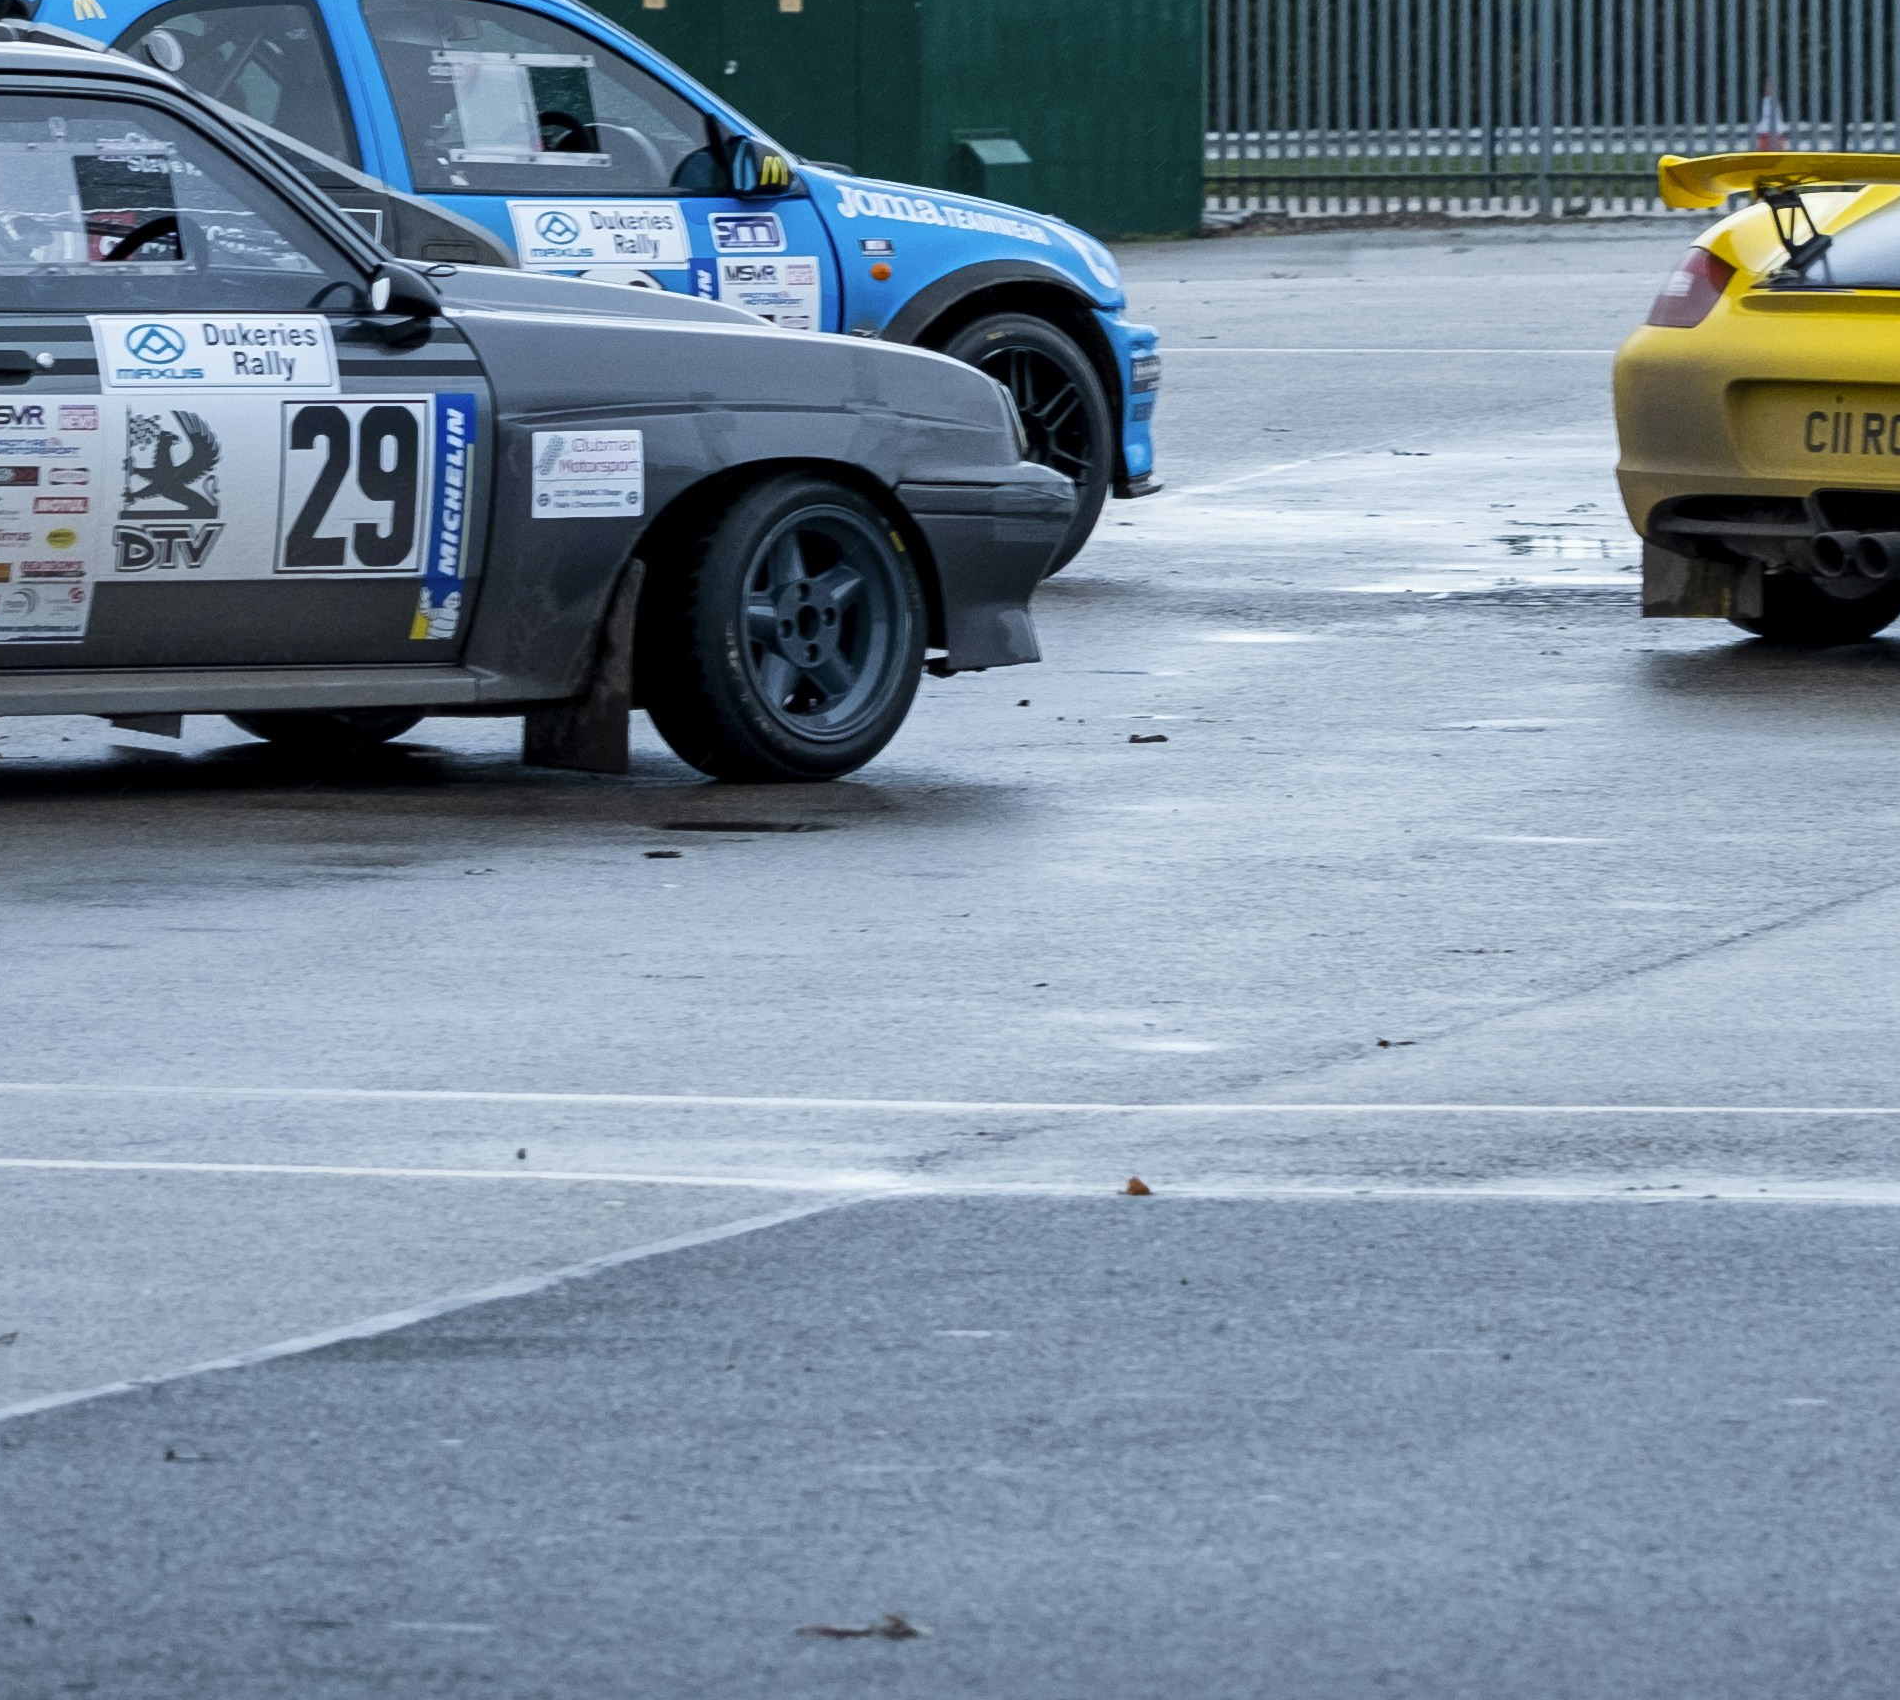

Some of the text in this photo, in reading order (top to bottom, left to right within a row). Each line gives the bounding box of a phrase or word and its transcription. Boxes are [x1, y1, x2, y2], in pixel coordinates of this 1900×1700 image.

[835, 184, 947, 226] Joma
[590, 210, 674, 231] Dukeries
[613, 233, 660, 259] Rally
[724, 265, 778, 282] MSVR
[202, 322, 319, 347] Dukeries
[116, 368, 205, 380] MAXUS
[232, 350, 298, 382] Rally
[559, 459, 641, 476] Motorsport
[285, 405, 420, 568] 29
[438, 407, 465, 577] MICHELIN
[113, 522, 227, 573] DTV
